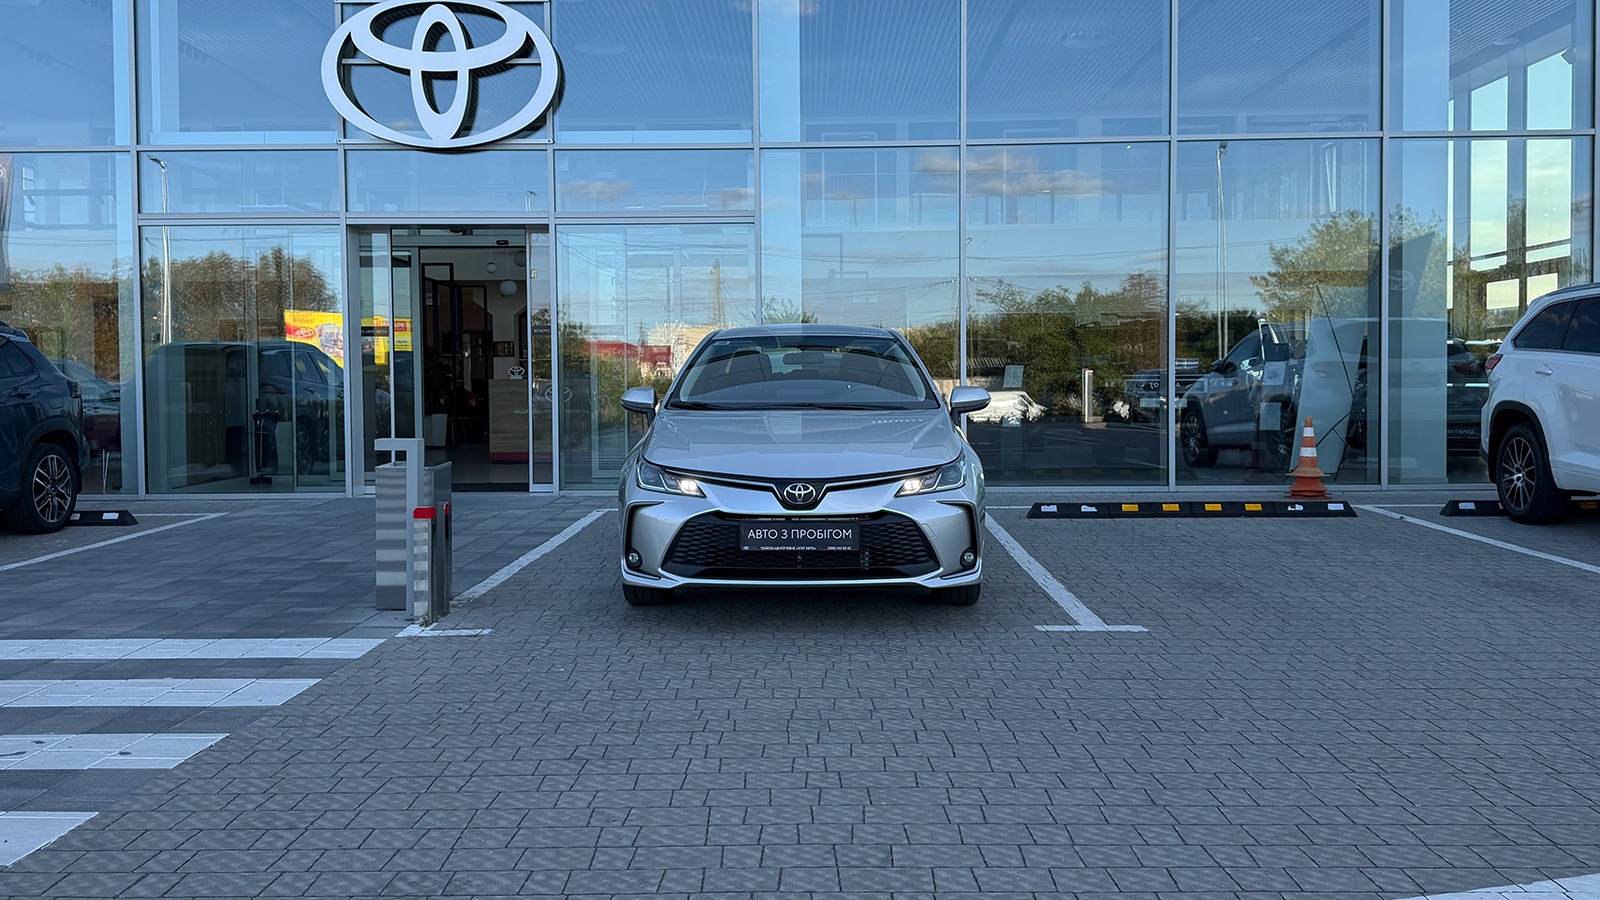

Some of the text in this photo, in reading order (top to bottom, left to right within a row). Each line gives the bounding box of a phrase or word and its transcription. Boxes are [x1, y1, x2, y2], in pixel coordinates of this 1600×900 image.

[747, 529, 852, 539] АВТО З ПРОБІГОМ
